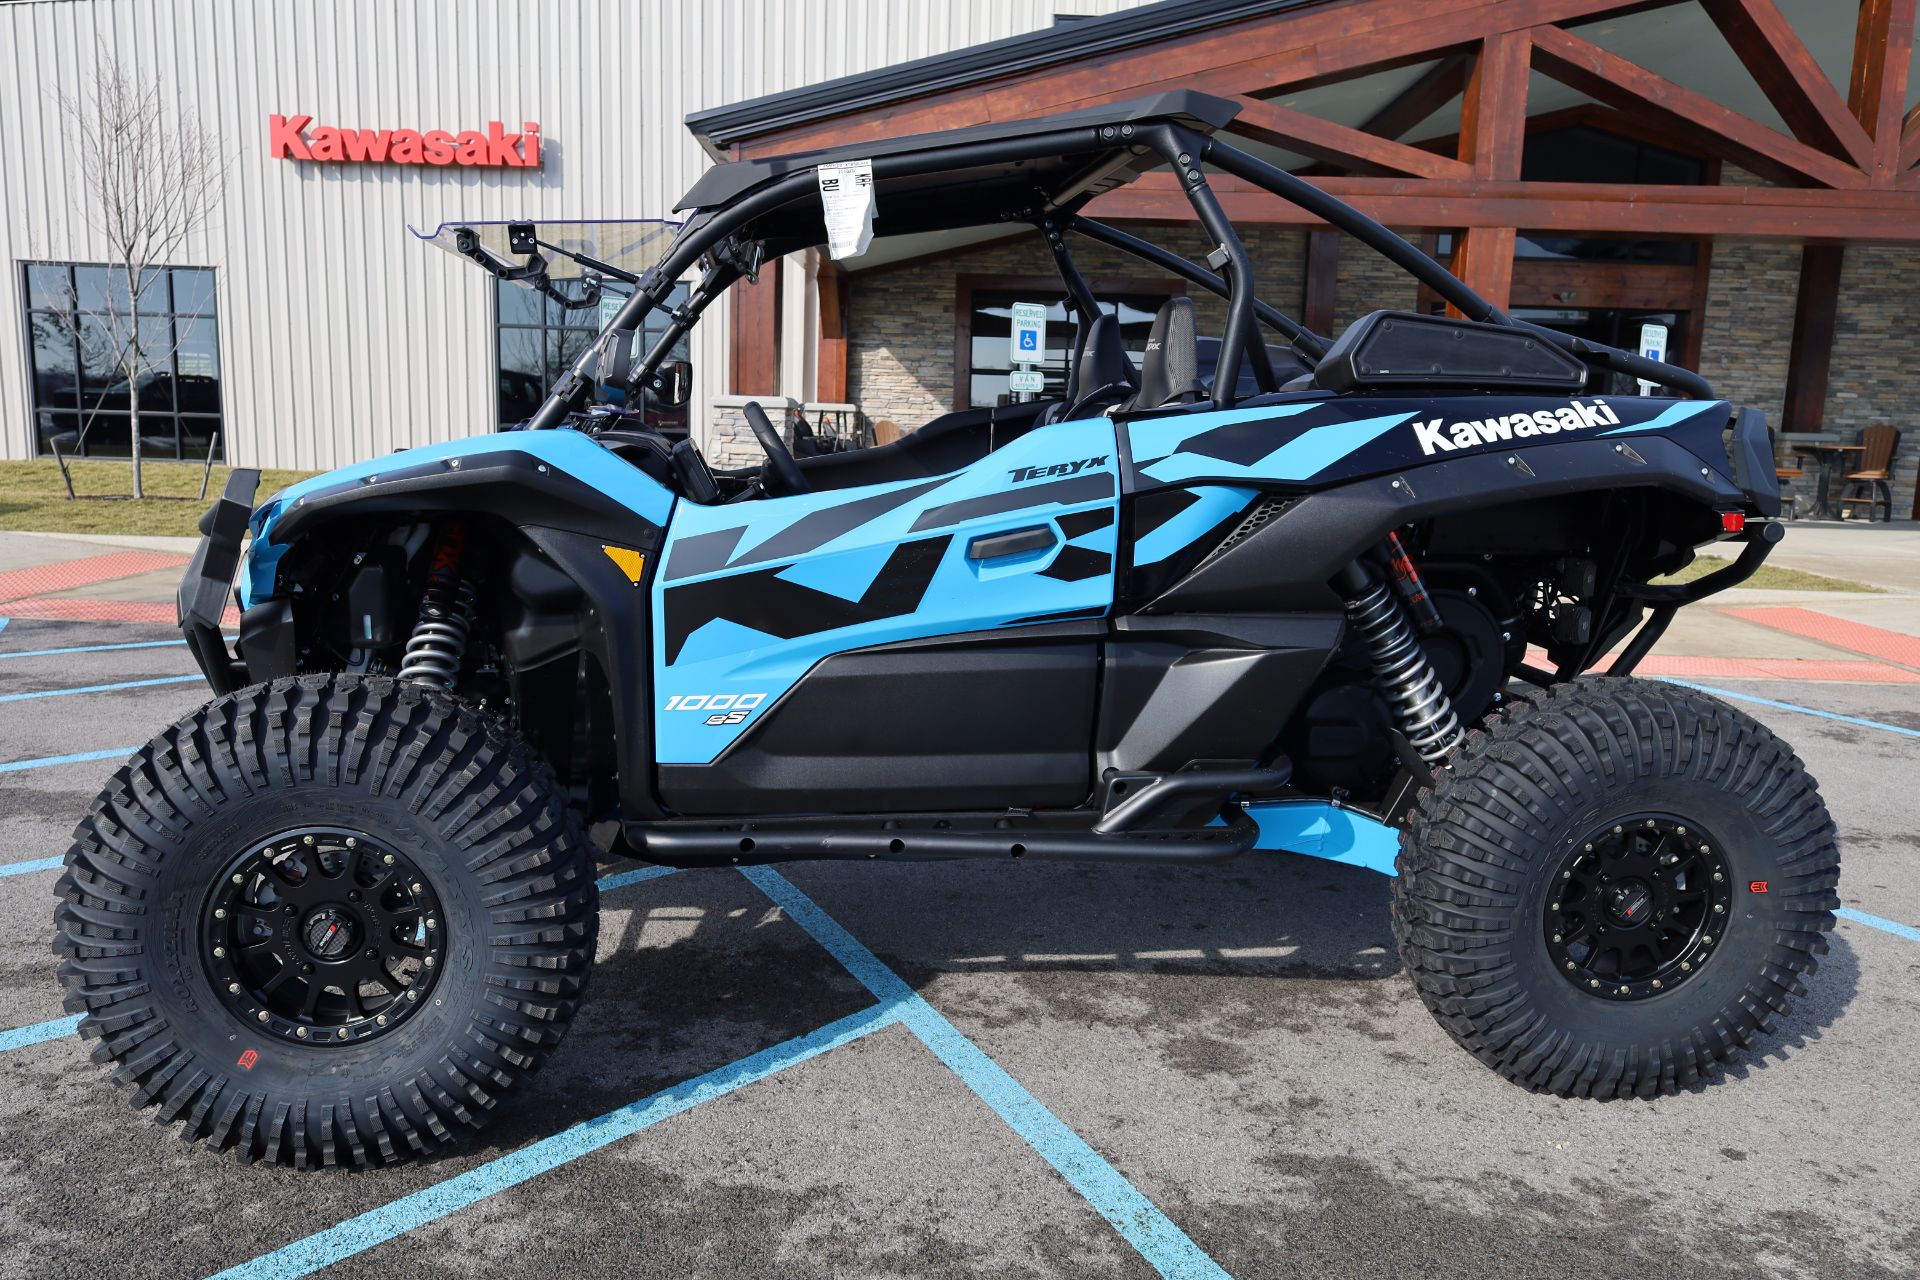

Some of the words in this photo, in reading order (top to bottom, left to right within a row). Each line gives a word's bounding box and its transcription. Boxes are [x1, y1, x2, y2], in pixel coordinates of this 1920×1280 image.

[270, 114, 540, 167] Kawasaki
[821, 179, 840, 192] BU
[1015, 308, 1044, 319] RESERVED
[1016, 319, 1041, 329] PARKING
[1018, 375, 1036, 383] VAN
[1412, 398, 1621, 456] Kawasaki
[1008, 454, 1110, 483] TERYX
[663, 693, 768, 711] 1000
